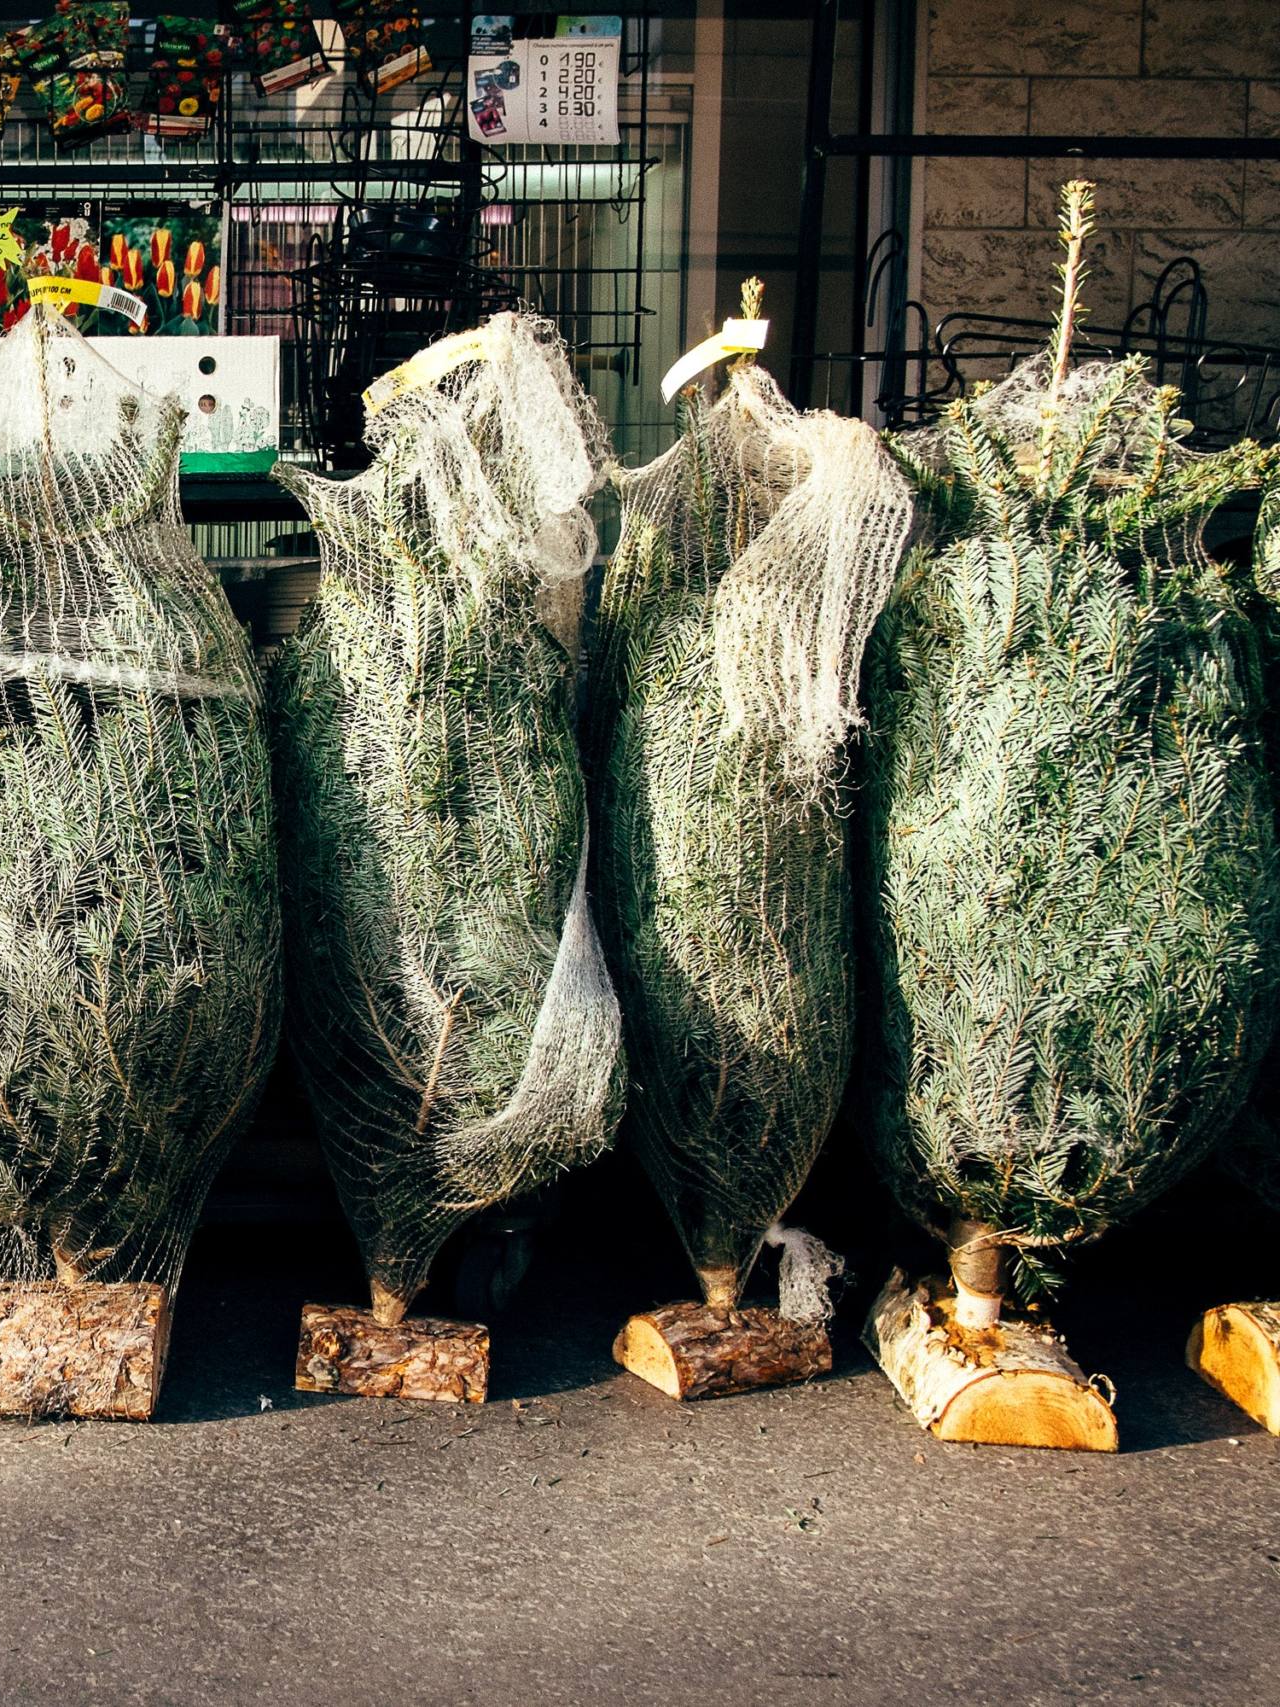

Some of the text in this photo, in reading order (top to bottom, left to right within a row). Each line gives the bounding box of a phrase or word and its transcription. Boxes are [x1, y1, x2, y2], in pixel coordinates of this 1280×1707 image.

[158, 41, 191, 51] Vilmorin
[540, 55, 548, 66] 0
[540, 71, 546, 81] 1
[539, 87, 548, 98] 2
[539, 103, 548, 113] 3
[539, 118, 548, 128] 4
